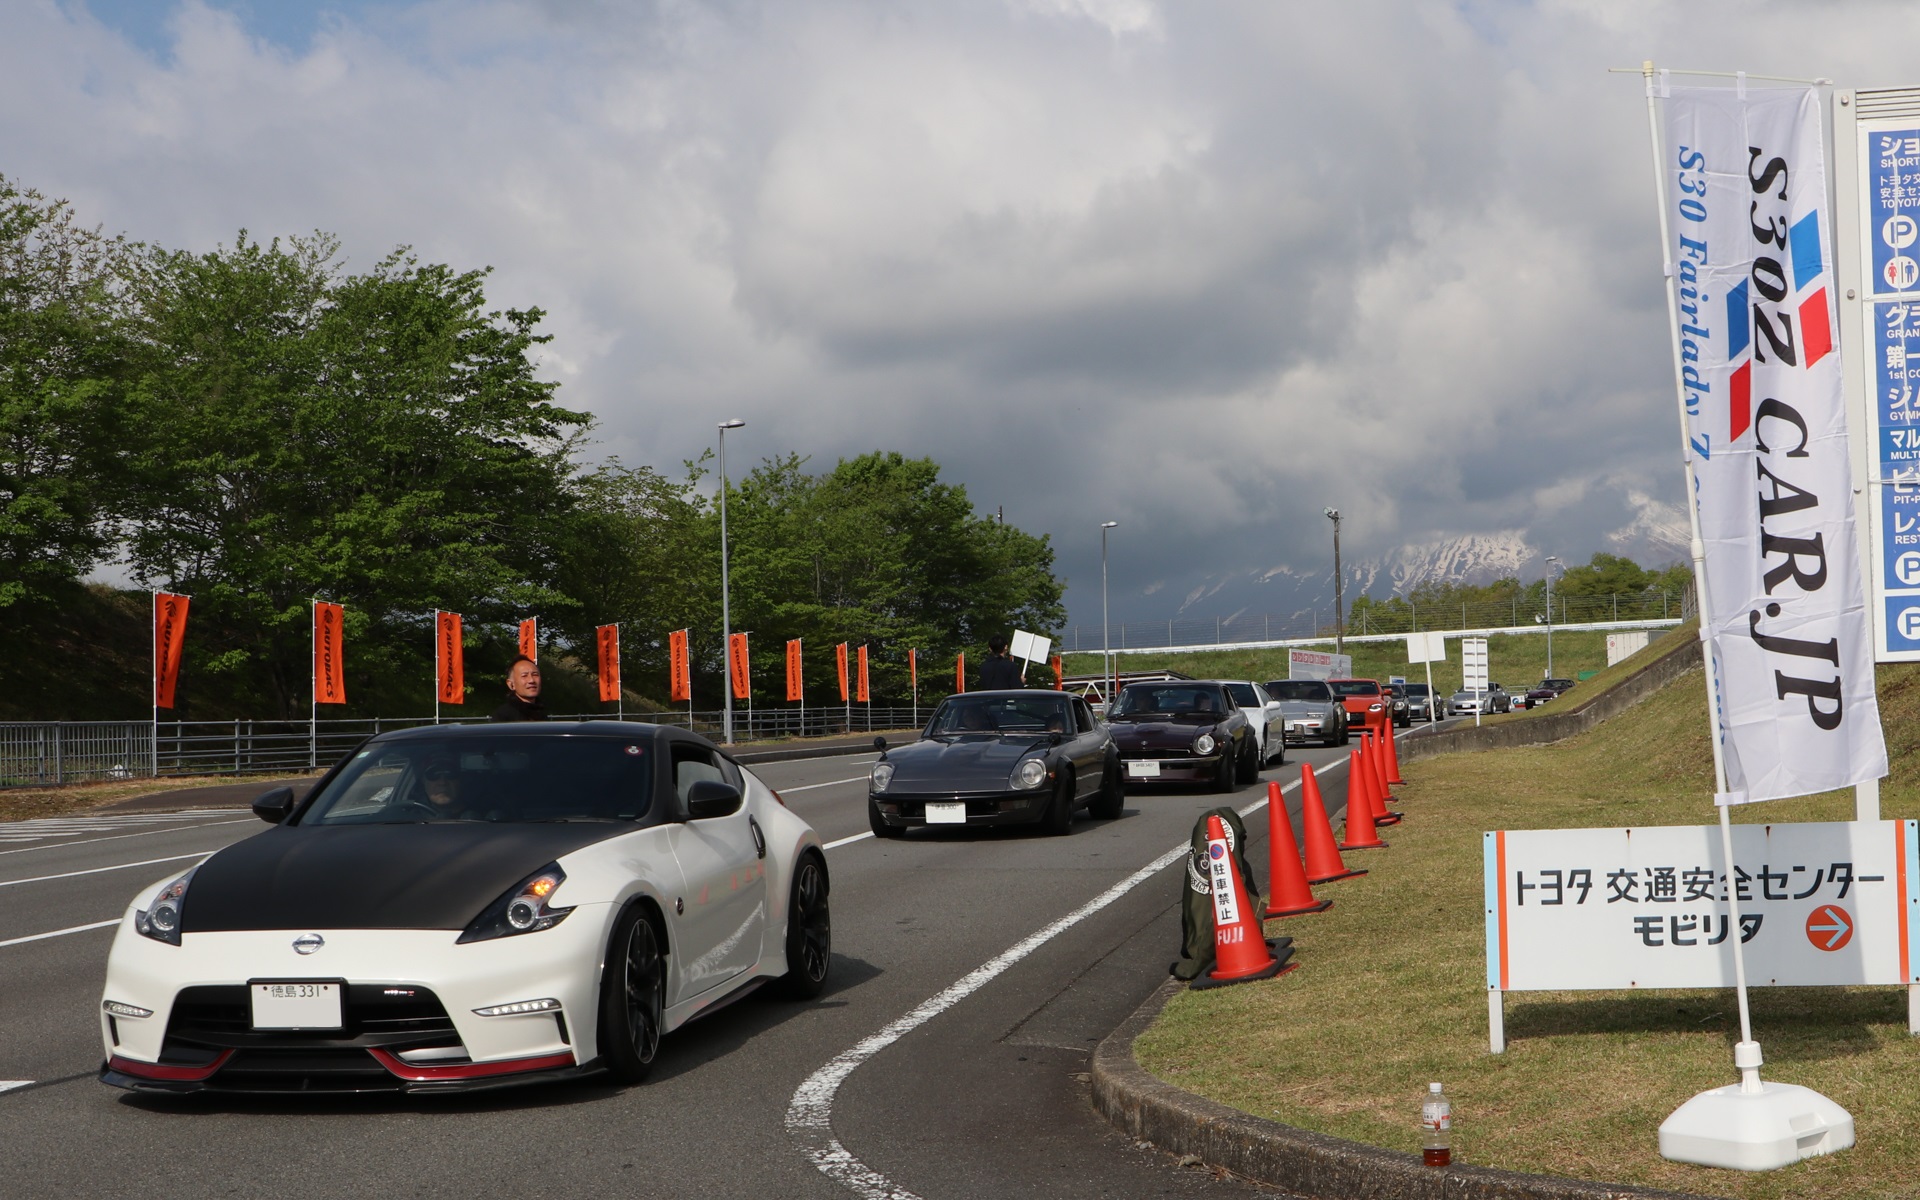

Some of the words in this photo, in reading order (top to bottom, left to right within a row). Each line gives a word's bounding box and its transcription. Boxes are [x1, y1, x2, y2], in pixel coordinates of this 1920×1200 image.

[1678, 145, 1708, 223] S30
[1880, 186, 1920, 199] 安全セ
[1750, 397, 1843, 731] CAR.JP
[323, 625, 335, 699] AUTOBACS
[446, 632, 454, 698] AUTOBACS
[1213, 863, 1232, 921] 駐車禁止
[1516, 869, 1593, 906] トヨタ
[1606, 862, 1885, 904] 交通安全センター
[1217, 926, 1244, 946] FUJI
[1634, 913, 1764, 947] モビリタ
